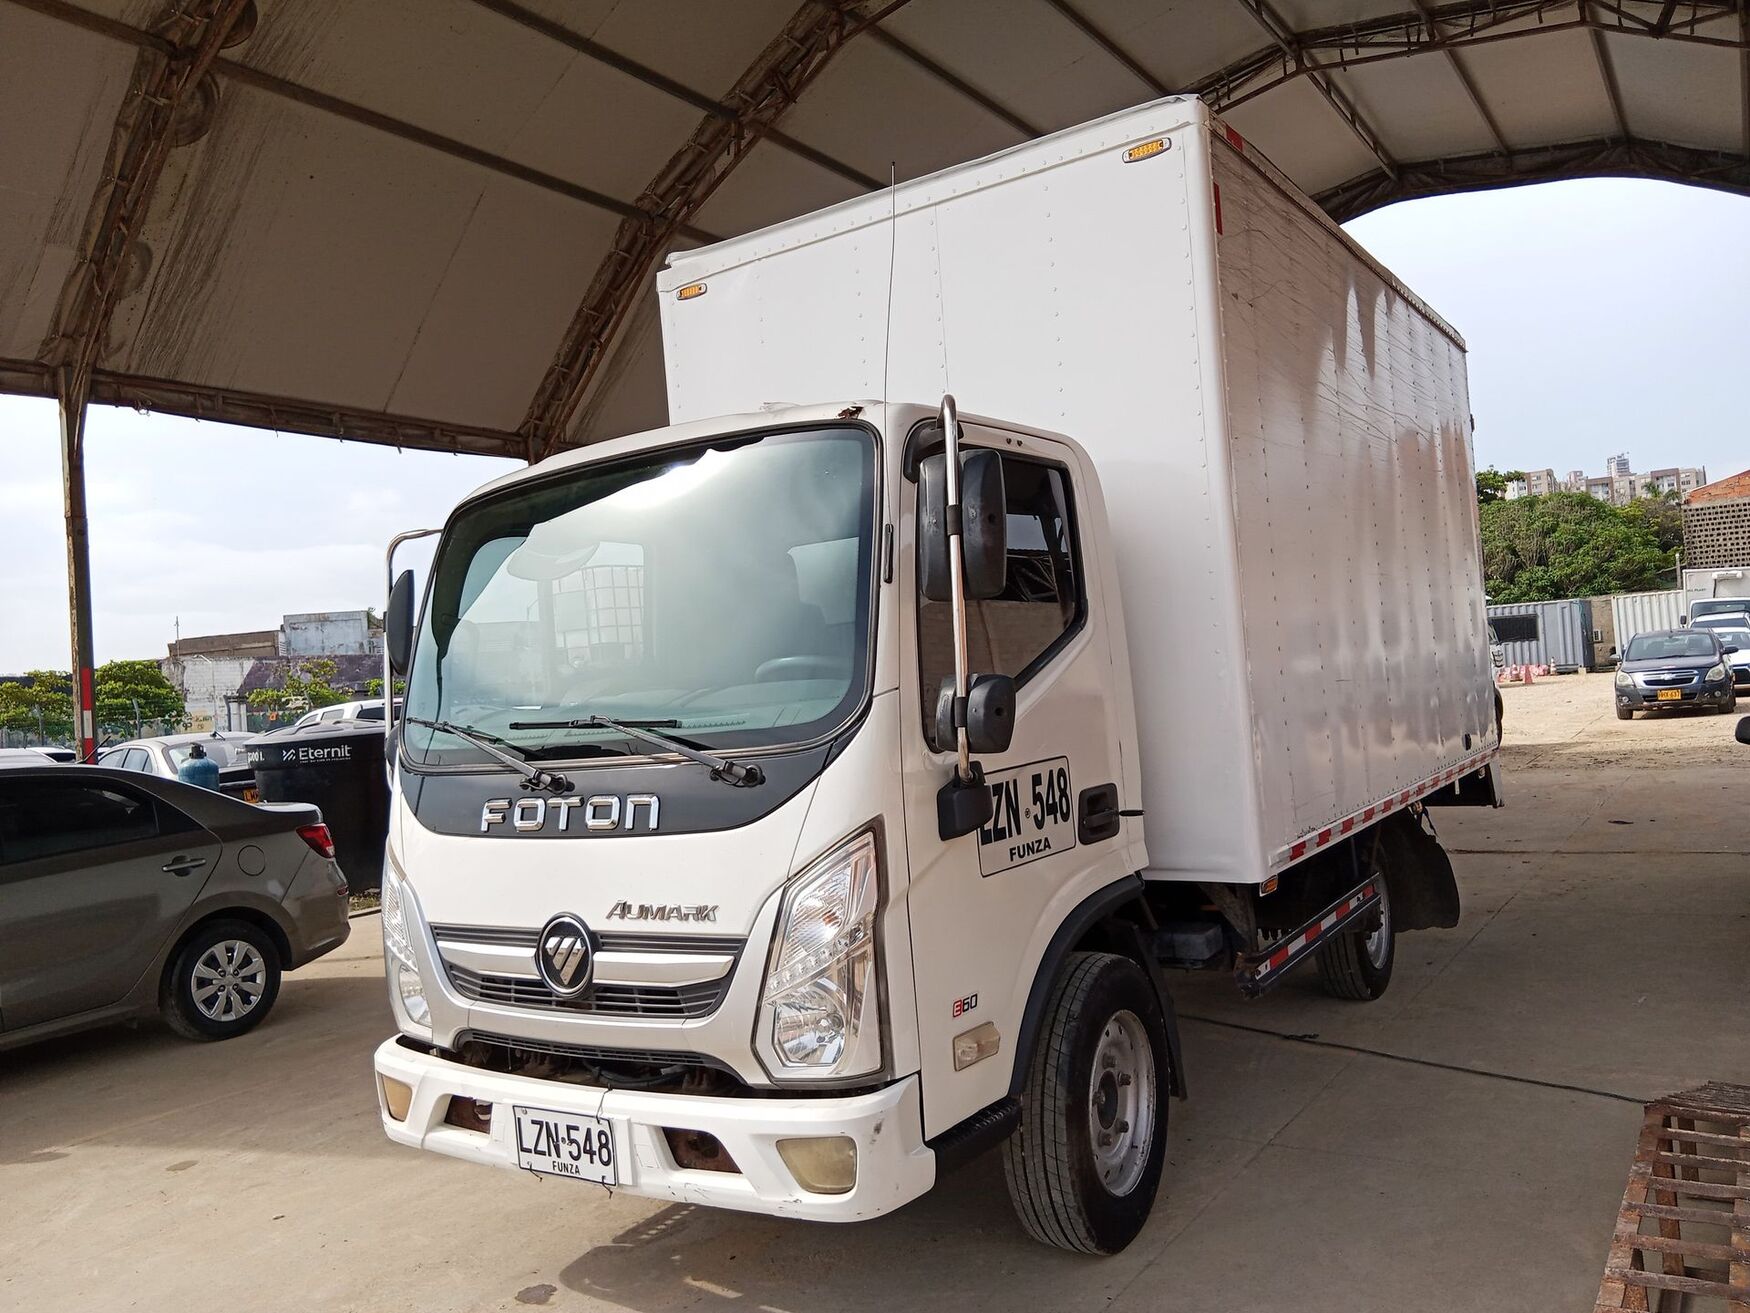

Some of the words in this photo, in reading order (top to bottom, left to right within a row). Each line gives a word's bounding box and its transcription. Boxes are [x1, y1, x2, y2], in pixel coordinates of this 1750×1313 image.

[298, 744, 352, 760] Eternit
[1031, 767, 1071, 830] 548
[481, 793, 661, 832] FOTON
[1009, 837, 1052, 862] FUNZA
[606, 899, 719, 922] AUMARK
[552, 1160, 581, 1176] FUNZA
